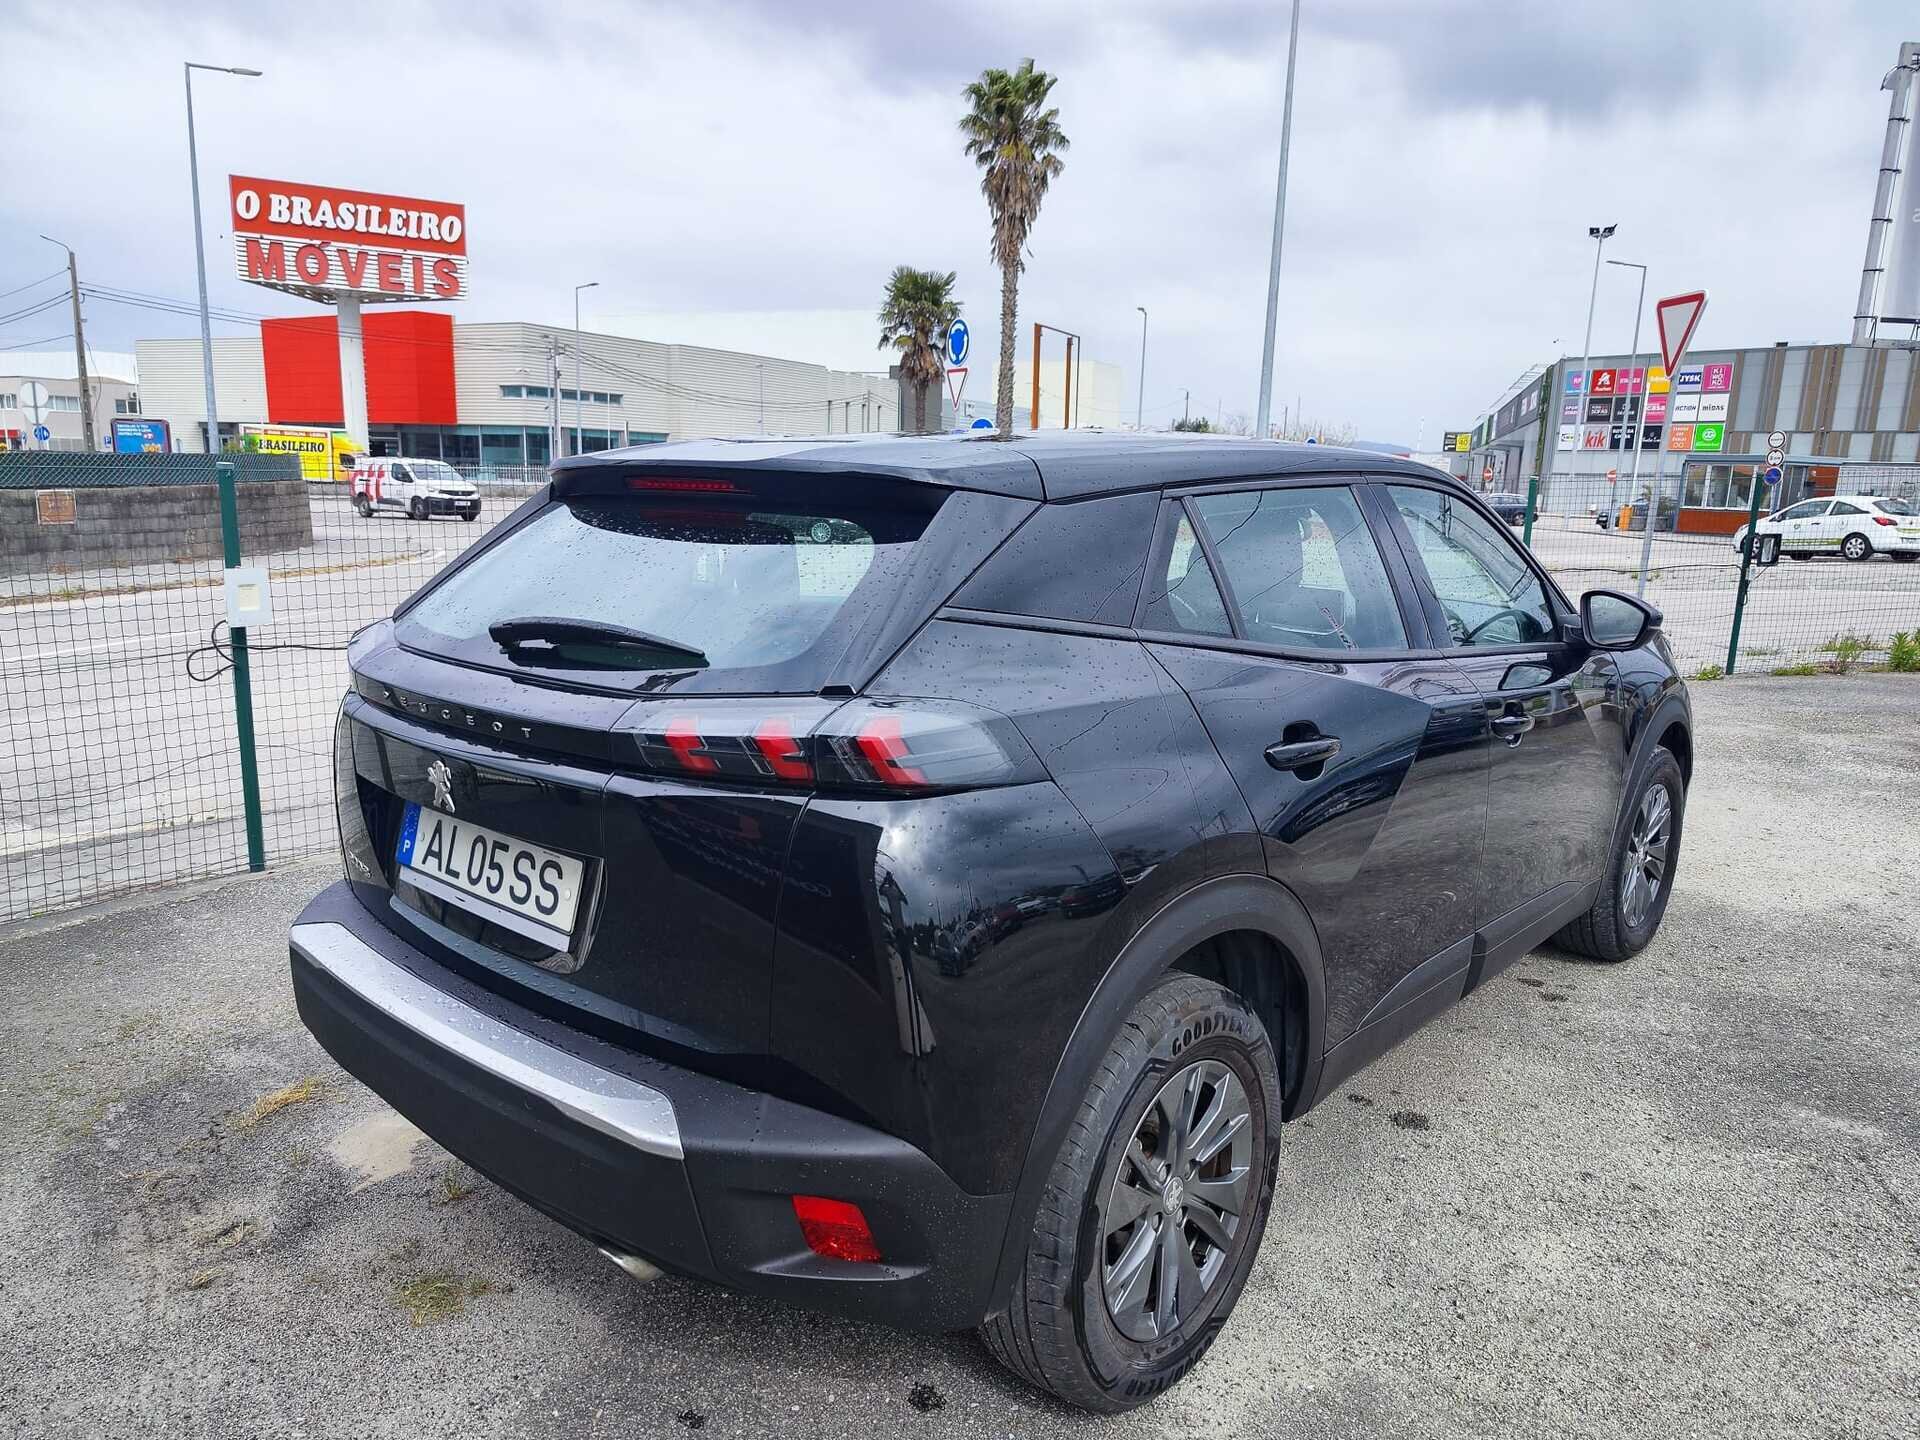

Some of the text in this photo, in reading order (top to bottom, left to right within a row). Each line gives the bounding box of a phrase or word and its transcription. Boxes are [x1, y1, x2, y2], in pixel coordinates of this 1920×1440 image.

[236, 190, 462, 243] O BRASILEIRO
[245, 239, 461, 297] MÓVEIS
[1584, 431, 1606, 448] kik
[382, 690, 532, 739] PEUGEOT
[403, 839, 411, 853] P
